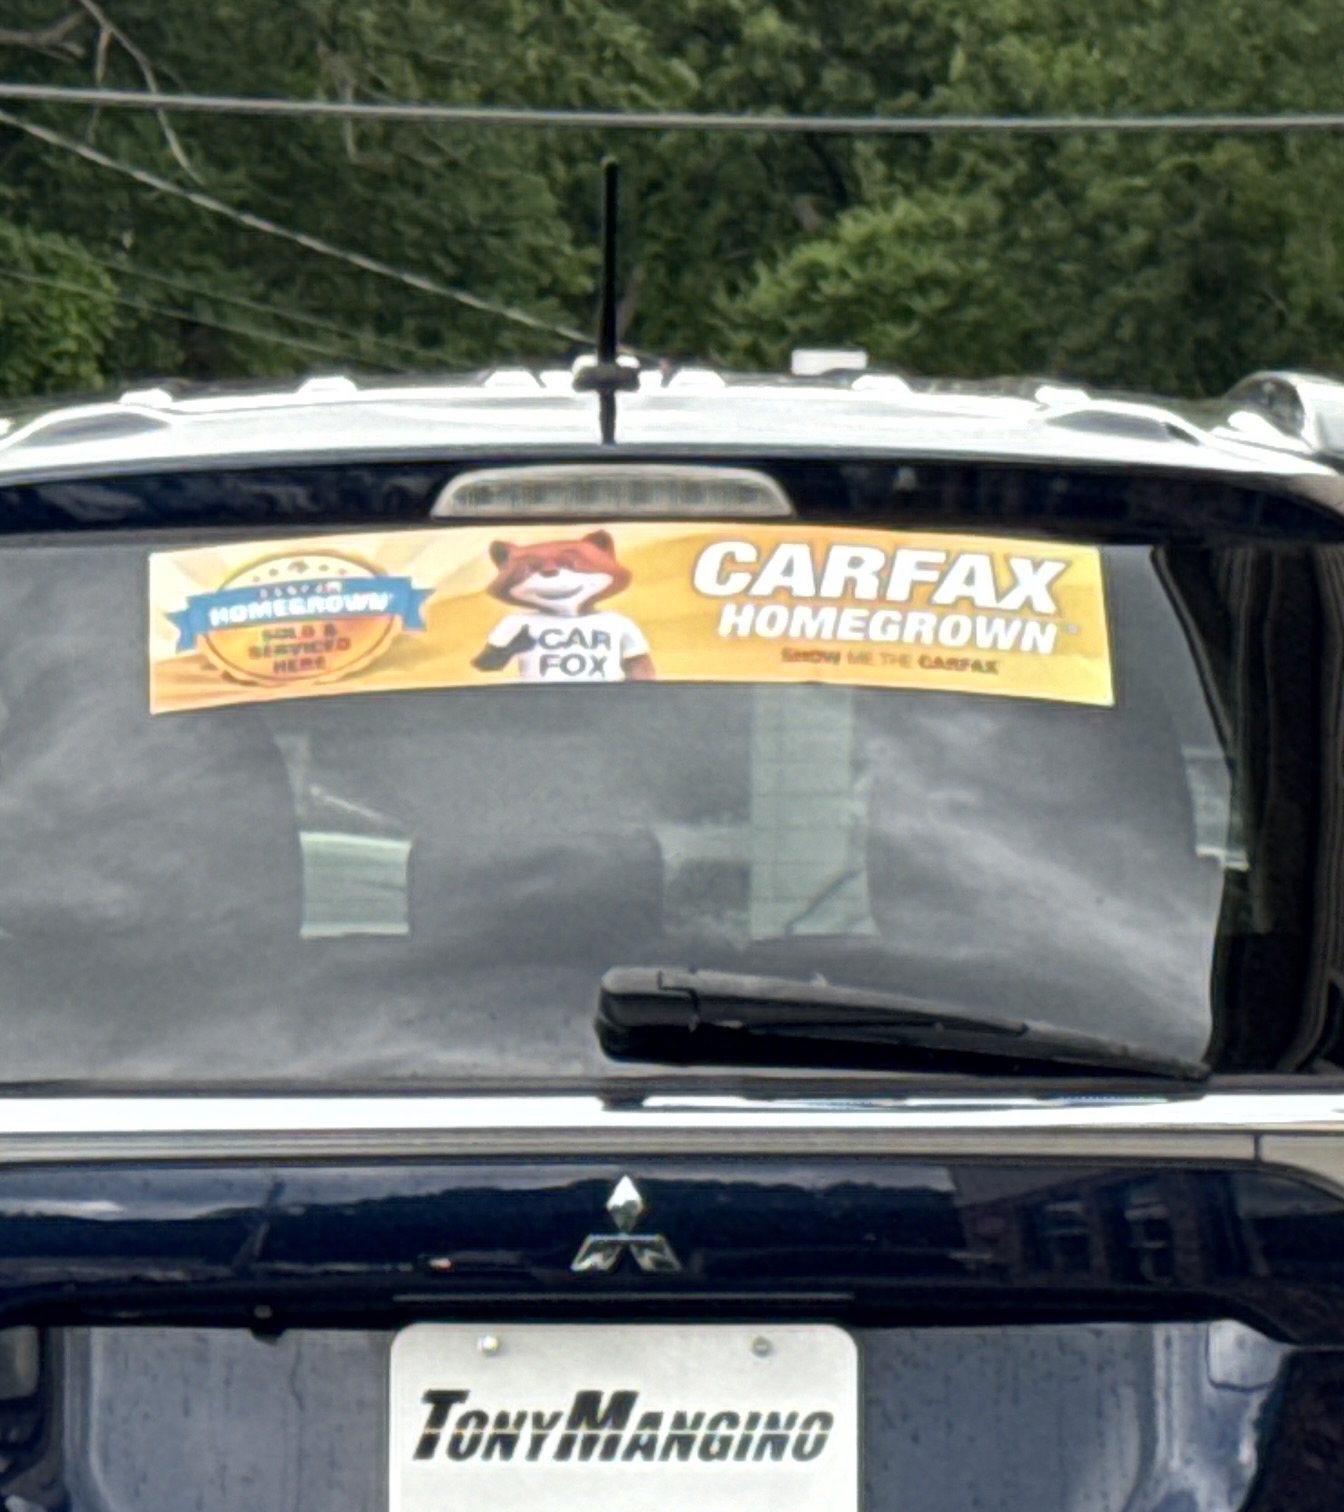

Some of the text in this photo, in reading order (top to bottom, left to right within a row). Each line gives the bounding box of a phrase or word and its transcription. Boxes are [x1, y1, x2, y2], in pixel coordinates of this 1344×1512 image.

[692, 541, 1068, 615] CARFAX
[209, 592, 390, 627] HOMEGROWN
[538, 627, 611, 651] CAR
[717, 603, 1057, 654] HOMEGROWN
[539, 653, 607, 677] FOX
[917, 655, 1000, 675] CARFAX
